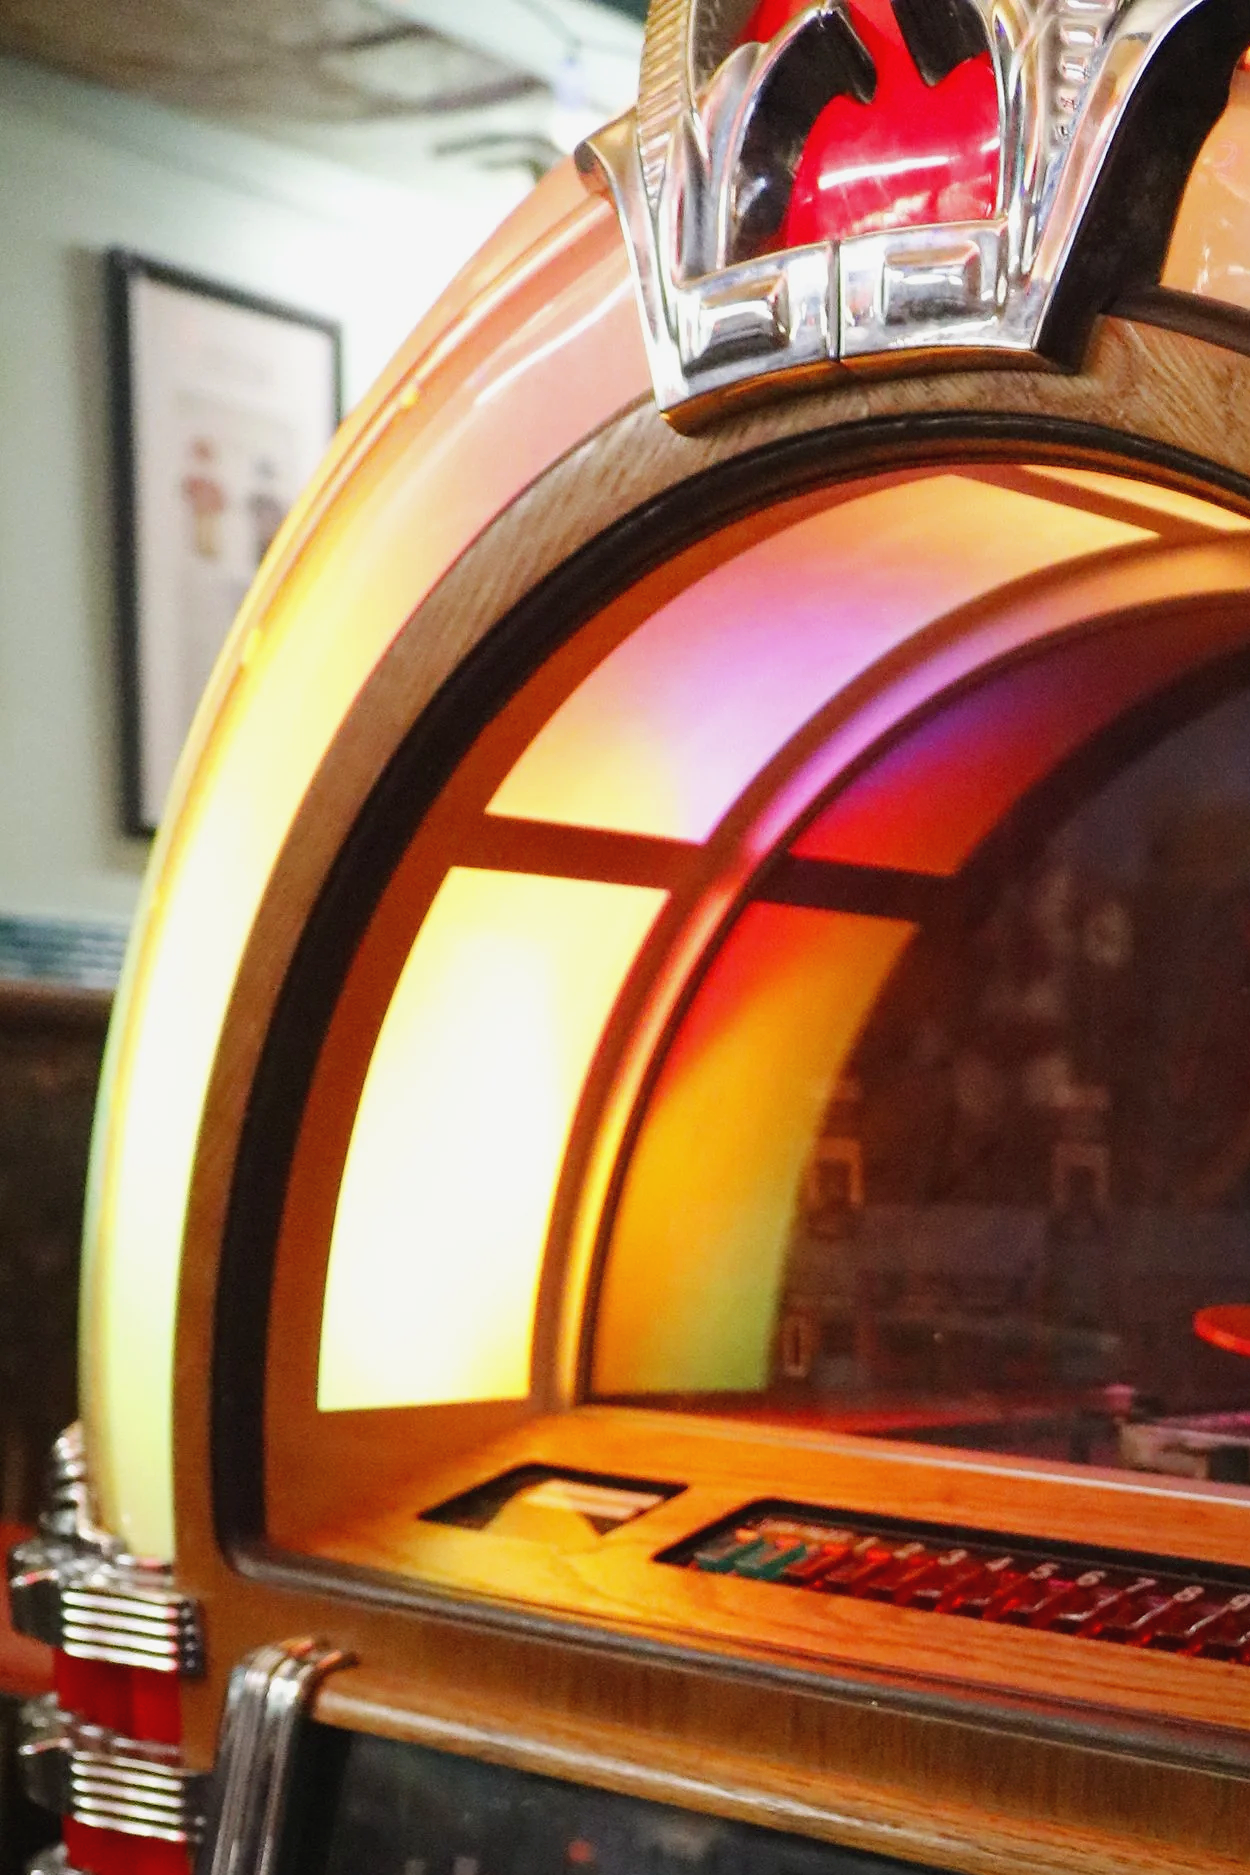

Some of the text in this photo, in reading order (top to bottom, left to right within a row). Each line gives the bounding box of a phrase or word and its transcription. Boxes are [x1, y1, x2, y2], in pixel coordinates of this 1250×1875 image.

[938, 1549, 969, 1567] 3
[1028, 1562, 1061, 1581] 5
[1075, 1570, 1107, 1588] 6
[1173, 1585, 1205, 1603] 8
